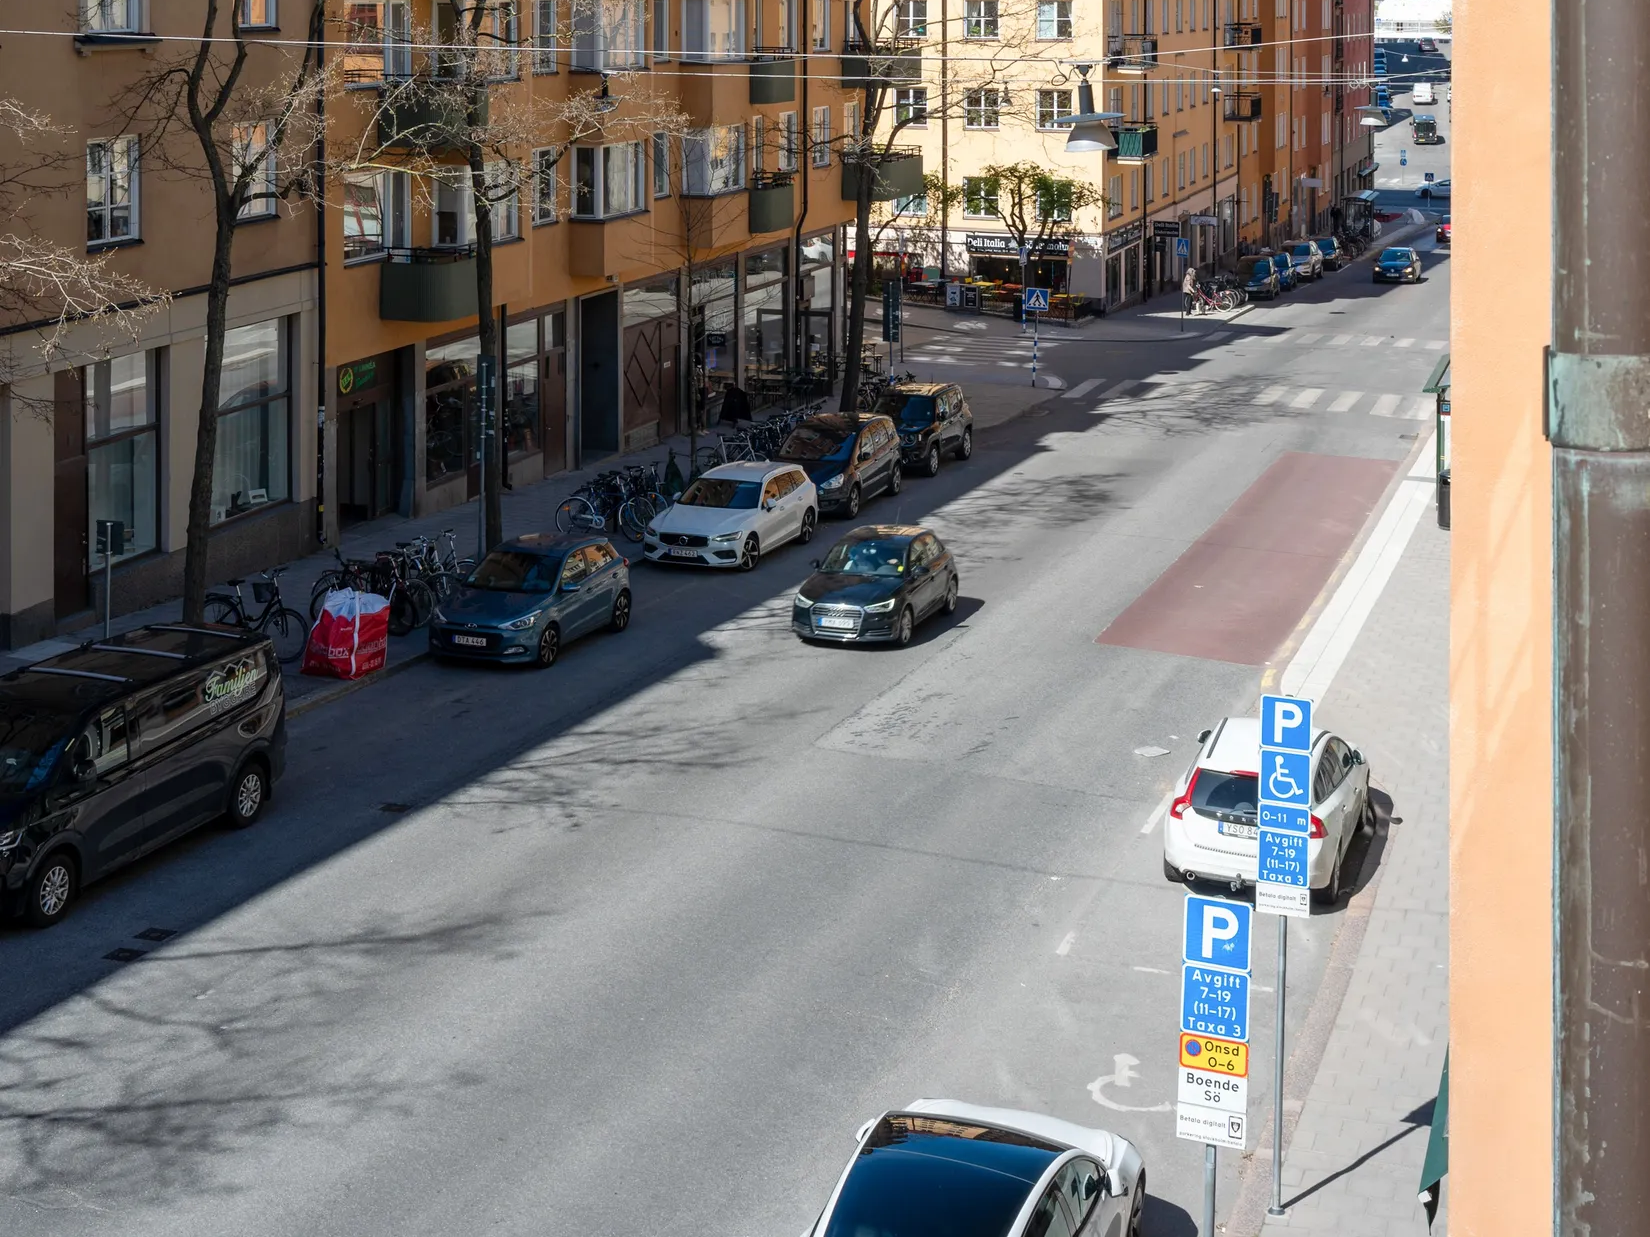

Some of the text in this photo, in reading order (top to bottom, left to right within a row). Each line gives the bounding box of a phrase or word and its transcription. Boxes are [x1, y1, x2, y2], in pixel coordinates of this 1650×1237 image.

[967, 237, 1005, 248] Deli Italia
[457, 635, 469, 643] DTA
[205, 666, 259, 702] Familjen
[1274, 701, 1303, 743] P
[1262, 811, 1307, 826] 0-11 m
[1265, 833, 1303, 847] Avgift
[1271, 846, 1296, 859] 7-19
[1266, 857, 1300, 873] (11-17)
[1262, 870, 1304, 885] Taxa 3
[1259, 891, 1276, 899] Betala
[1201, 904, 1239, 959] P
[1192, 969, 1240, 989] Avgift
[1200, 986, 1231, 1003] 7-19
[1193, 1000, 1236, 1021] (11-17)
[1187, 1016, 1242, 1037] Taxa 3
[1204, 1040, 1240, 1057] Onsd
[1208, 1056, 1235, 1071] 0-6
[1186, 1072, 1240, 1093] Boende
[1204, 1090, 1221, 1103] Sö
[1179, 1114, 1226, 1129] Betala digitalt
